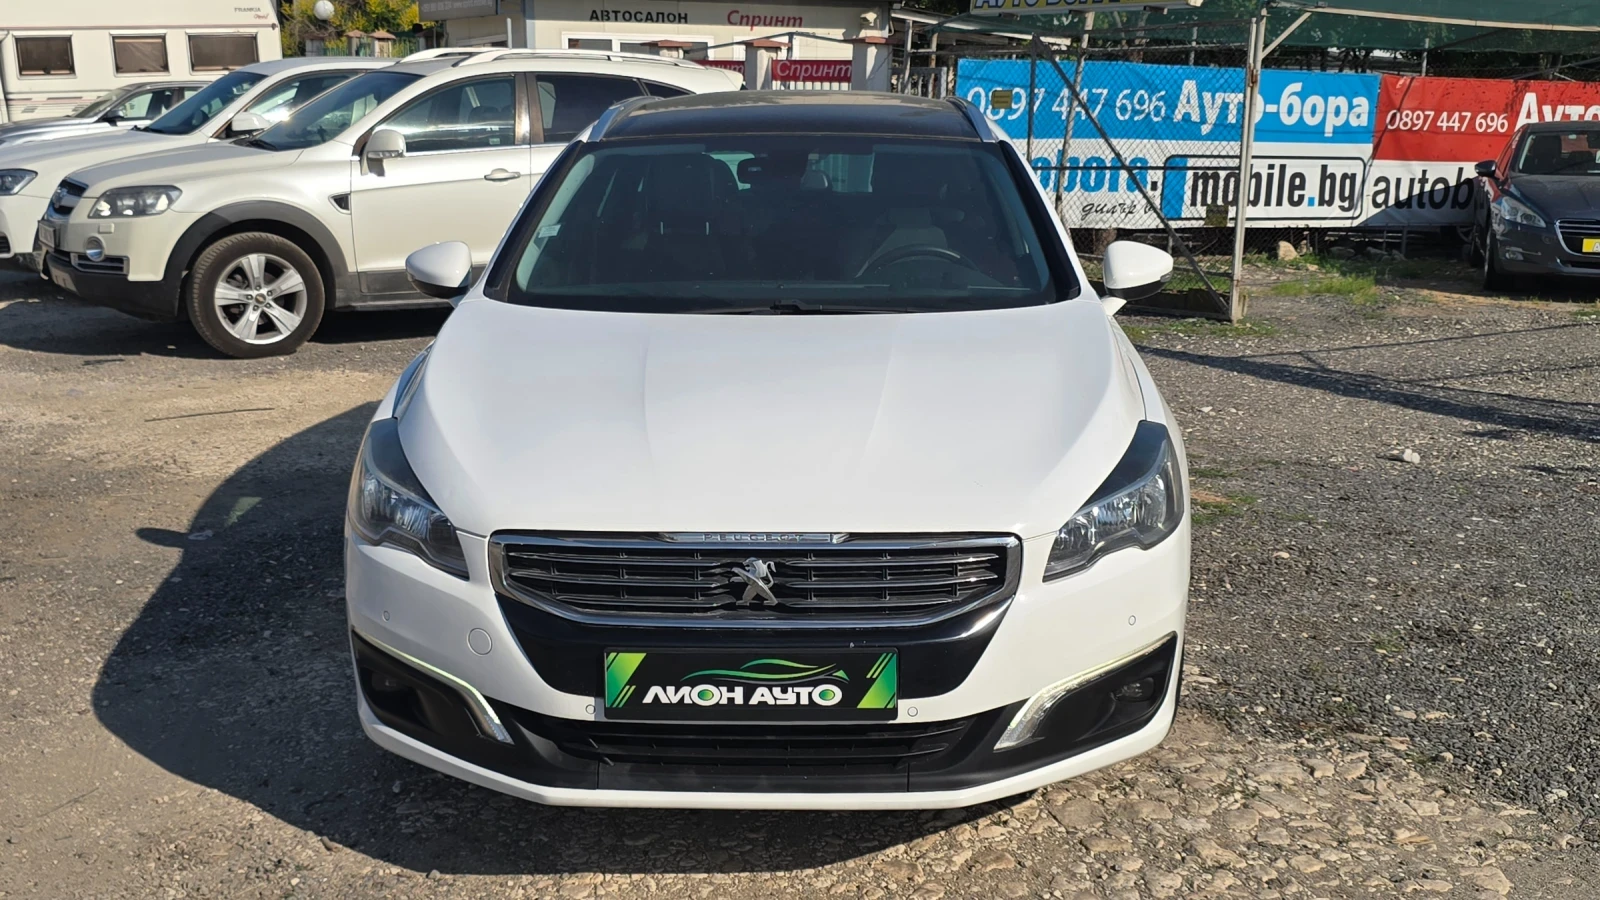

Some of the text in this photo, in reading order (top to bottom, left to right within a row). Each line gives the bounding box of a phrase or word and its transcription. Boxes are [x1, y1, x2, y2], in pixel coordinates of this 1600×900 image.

[590, 10, 688, 24] АВТОСАЛОН
[727, 10, 803, 31] Спринт
[777, 60, 851, 81] Спринт
[1115, 89, 1166, 122] 696
[1386, 109, 1435, 131] 0897
[1437, 111, 1472, 132] 447
[1475, 112, 1509, 133] 696
[703, 533, 803, 541] PEUGEOT
[642, 684, 843, 706] ЛИОН АУТО
